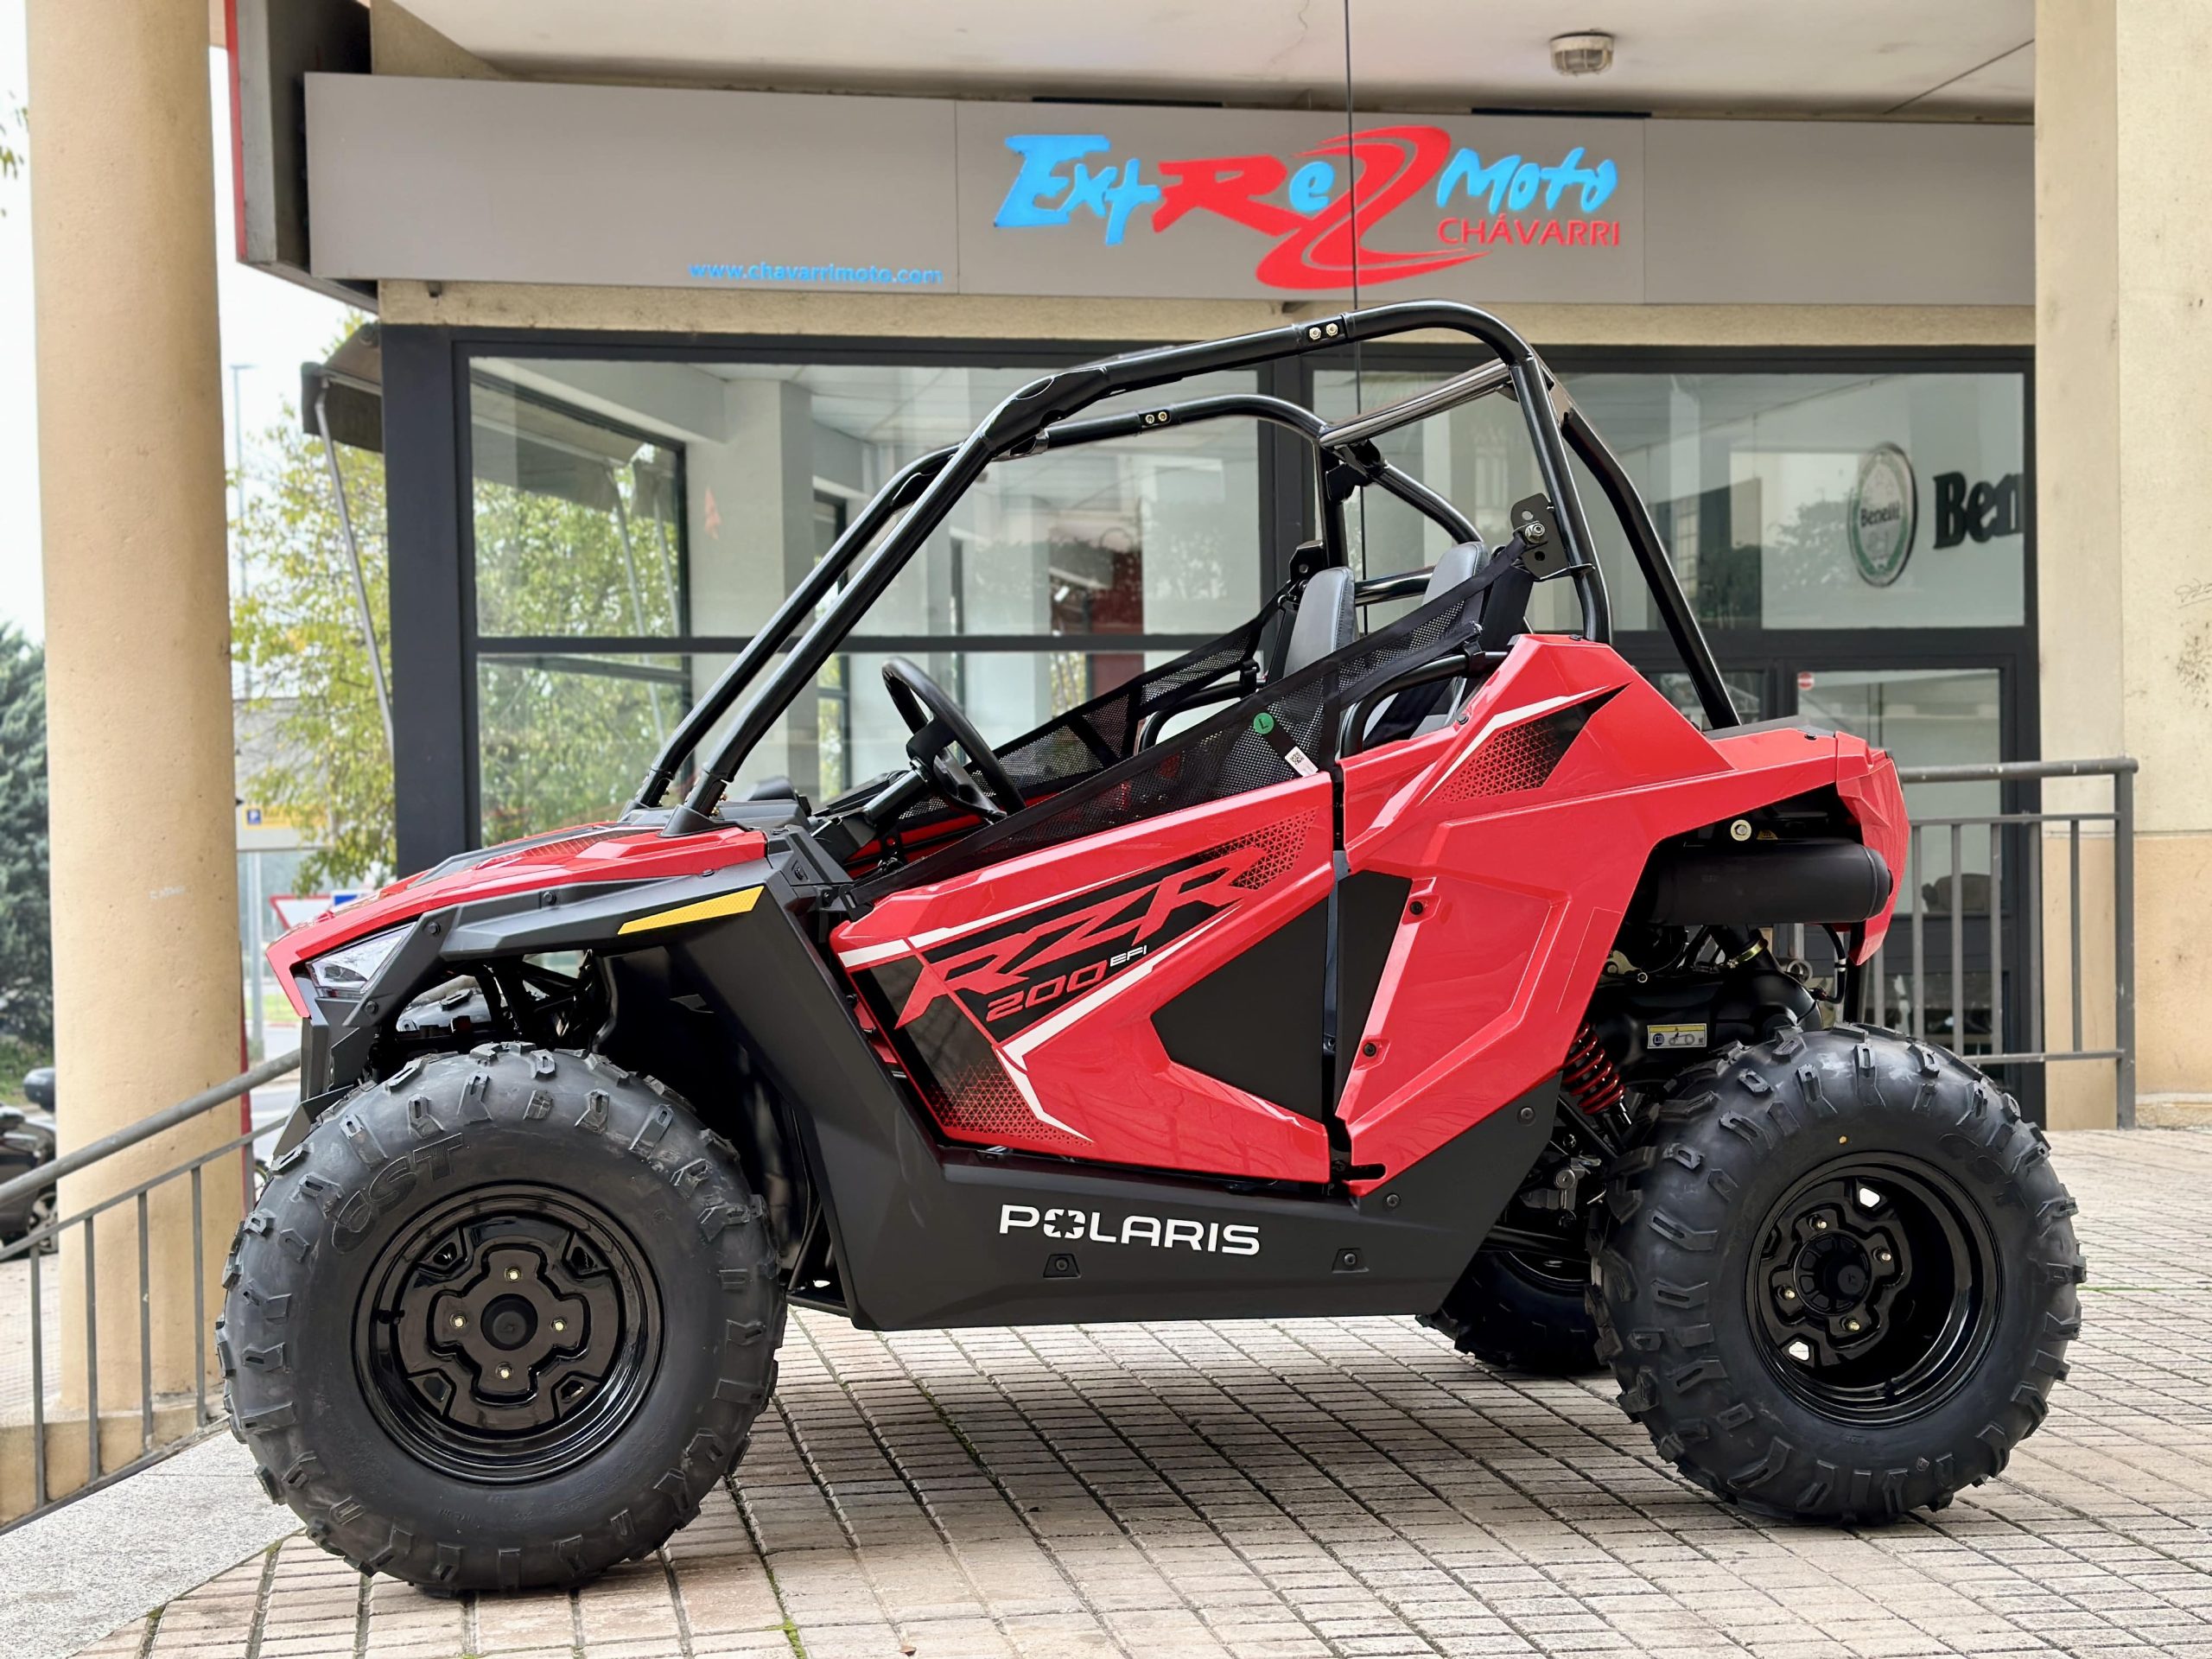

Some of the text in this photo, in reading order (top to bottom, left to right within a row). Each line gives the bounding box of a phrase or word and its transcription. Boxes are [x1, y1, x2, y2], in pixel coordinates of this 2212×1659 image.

[1436, 148, 1618, 213] Moto
[1437, 217, 1621, 247] CHÁVARRI
[688, 262, 944, 284] www.chavarrimoto.com
[896, 847, 1268, 1028] RZR
[986, 945, 1147, 1023] 200 EFI
[332, 1132, 463, 1255] CST
[999, 1204, 1261, 1255] POLARIS
